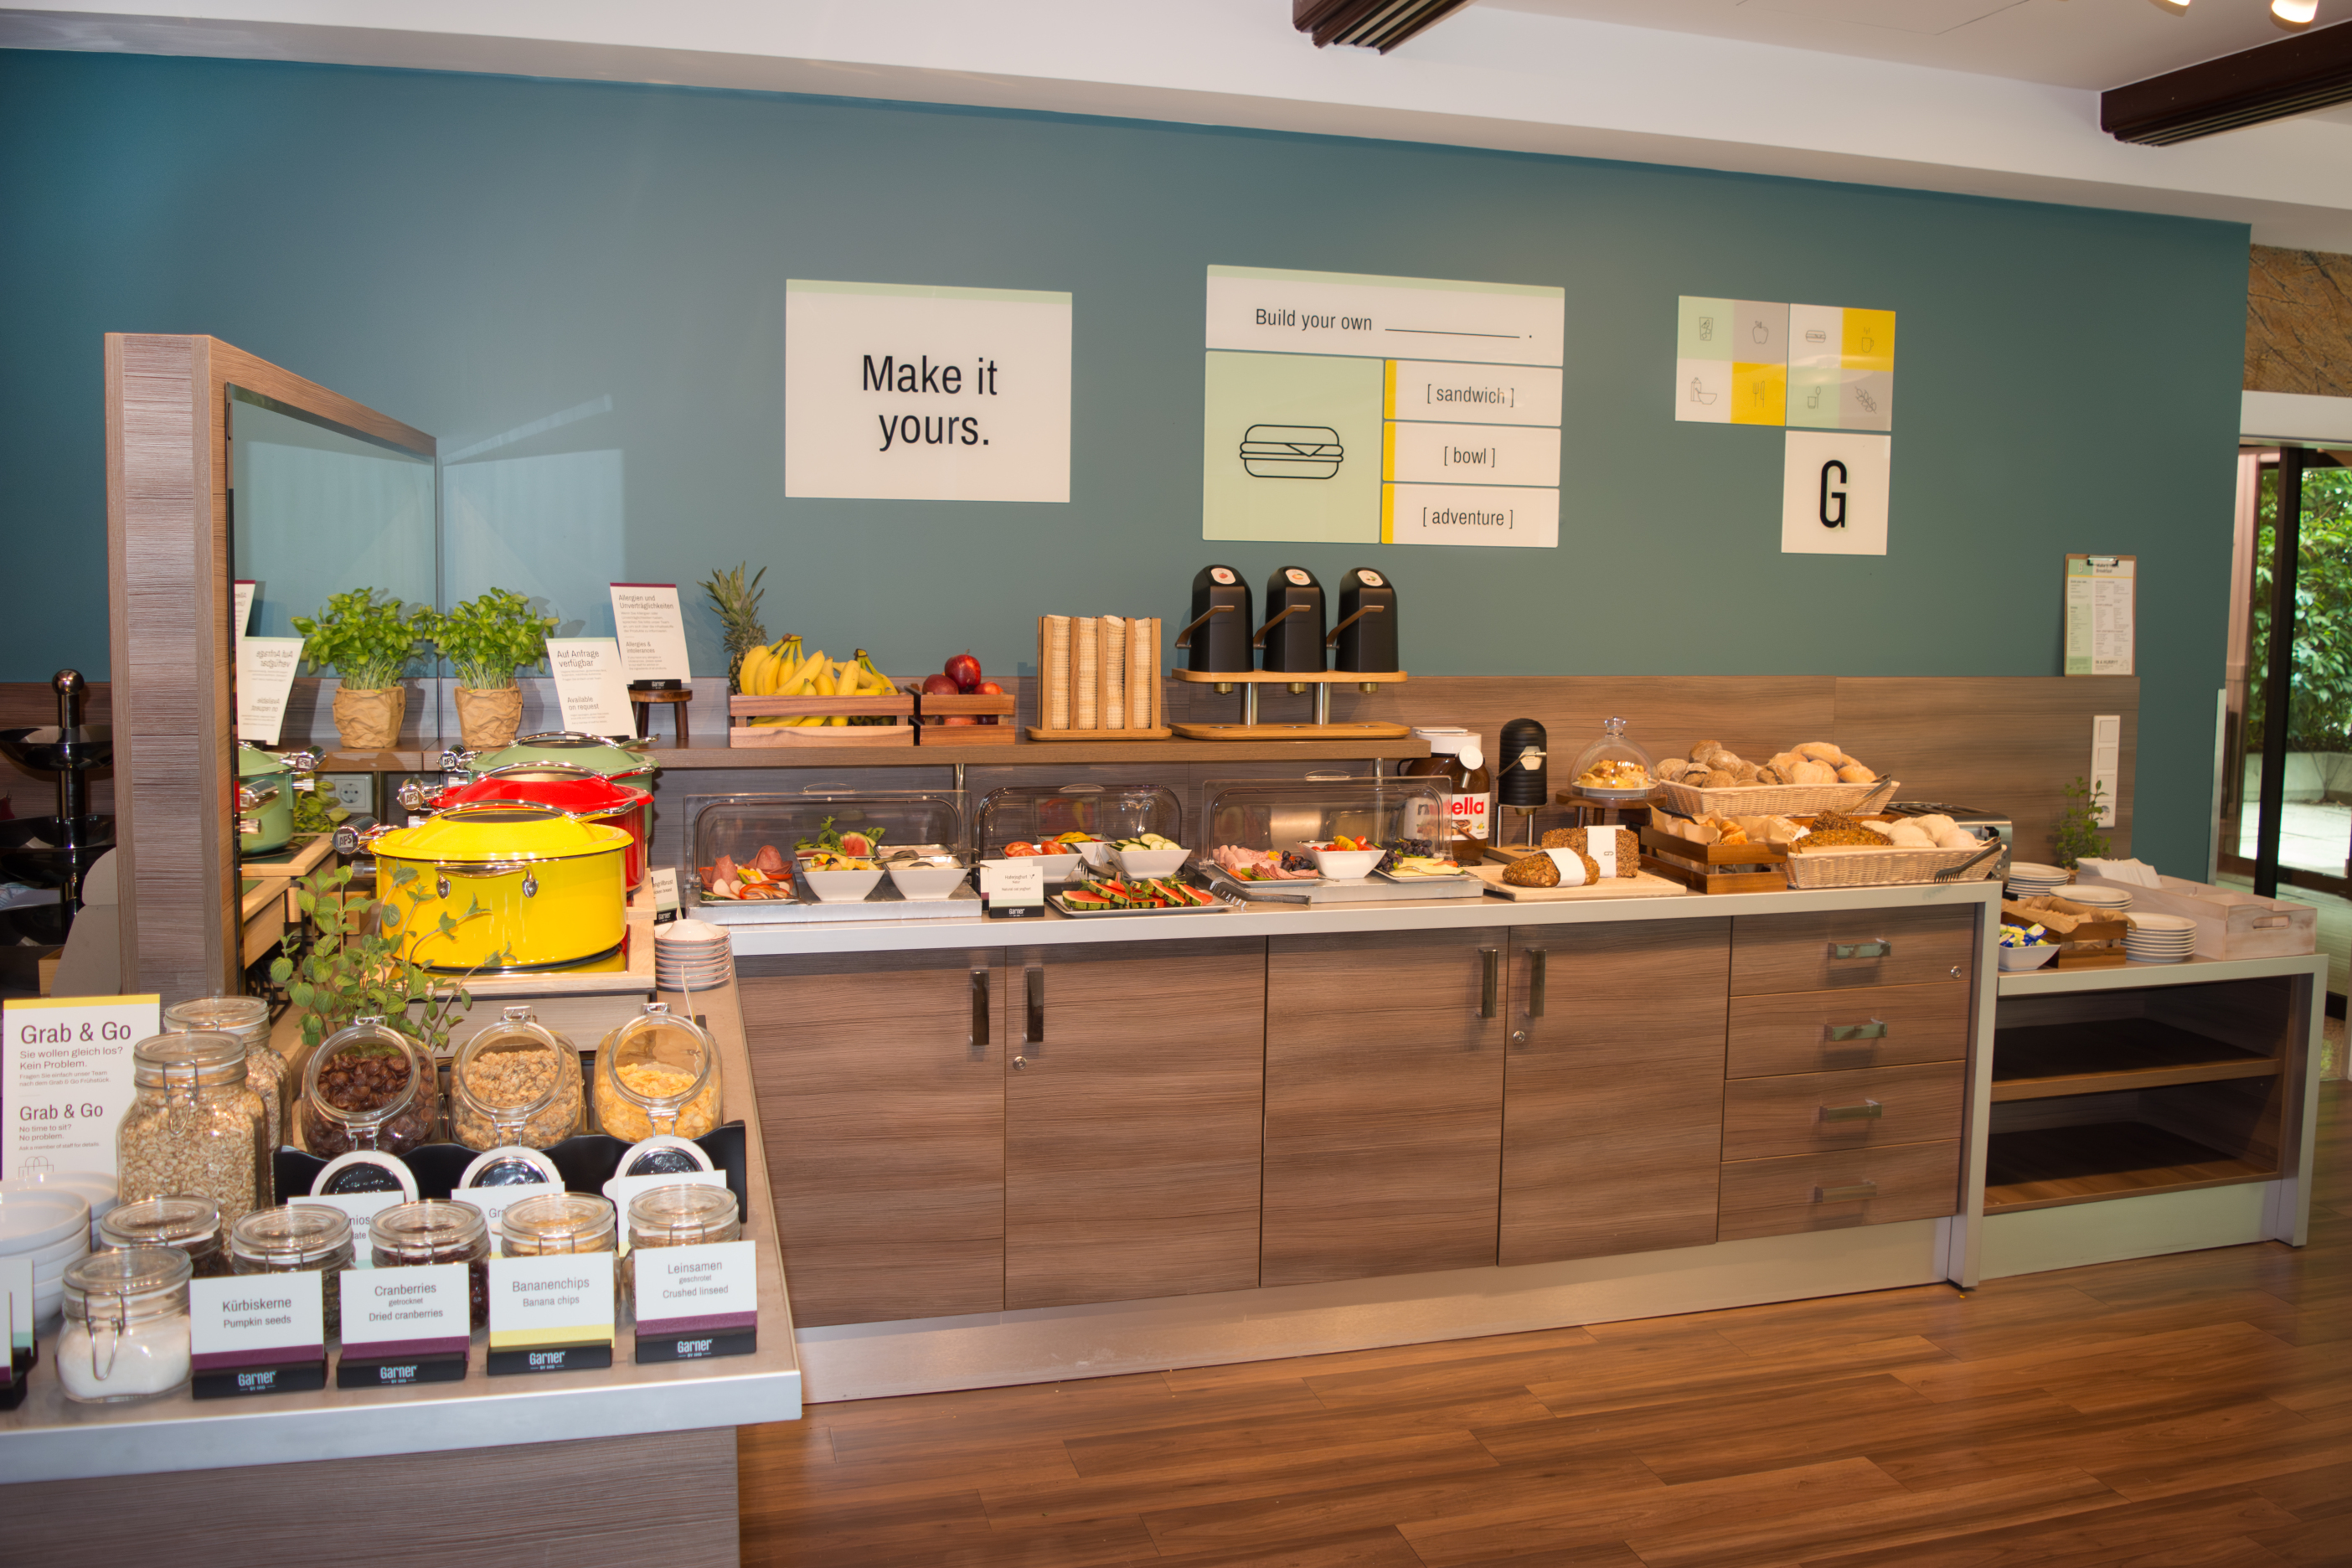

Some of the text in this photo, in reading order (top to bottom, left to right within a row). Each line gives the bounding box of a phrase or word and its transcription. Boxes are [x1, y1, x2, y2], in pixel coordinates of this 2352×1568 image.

[1256, 308, 1372, 332] Build your own
[864, 355, 998, 395] Make it
[1436, 386, 1505, 404] sandwich
[879, 415, 989, 451] yours.
[1453, 446, 1486, 464] bowl
[1819, 459, 1848, 529] G
[1432, 508, 1504, 525] adventure
[557, 650, 600, 659] Auf Anfrage
[559, 658, 594, 668] verfügbar
[406, 792, 418, 803] APS
[338, 835, 352, 846] APS
[21, 1021, 132, 1044] Grab & Go
[20, 1046, 123, 1060] Sie wollen gleich los?
[19, 1060, 87, 1070] Kein Problem.
[19, 1102, 104, 1121] Grab & Go
[31, 1133, 64, 1142] problem.
[668, 1261, 723, 1274] Leinsamen
[512, 1277, 590, 1292] Bananenchips
[678, 1275, 712, 1284] geschrotet
[374, 1282, 436, 1297] Cranberries
[663, 1285, 729, 1298] Crushed linseed
[222, 1298, 291, 1313] Kürbiskerne
[389, 1297, 423, 1308] getrocknet
[523, 1295, 580, 1307] Banana chips
[224, 1314, 291, 1328] Pumpkin seeds
[369, 1308, 443, 1322] Dried cranberries
[678, 1338, 713, 1354] Garner
[529, 1351, 565, 1365] Garner
[238, 1370, 276, 1386] Garner
[380, 1364, 417, 1380] Garner
